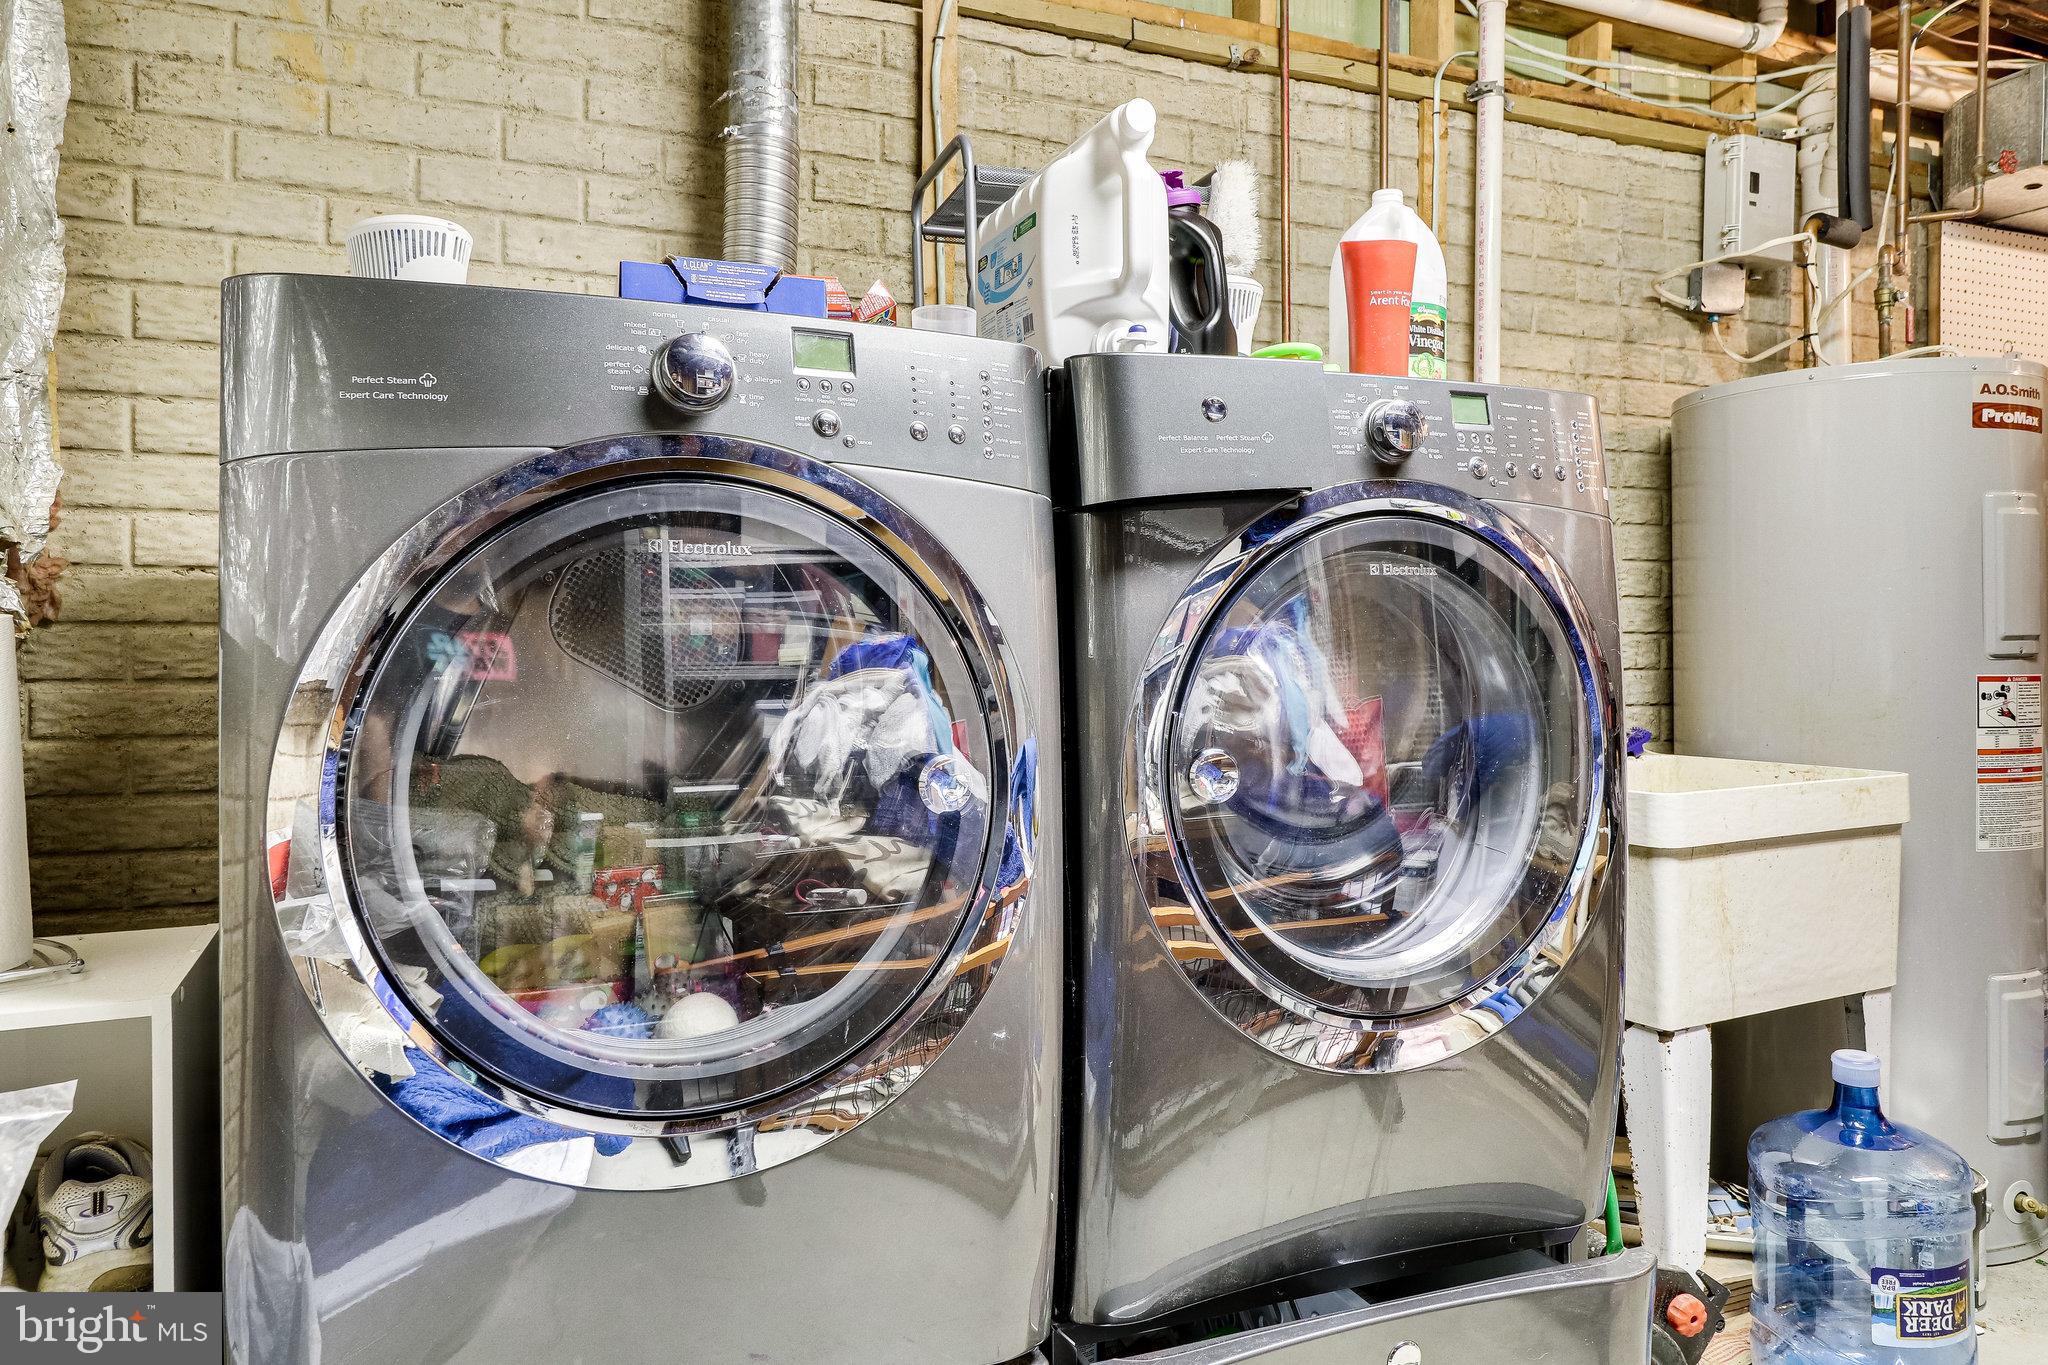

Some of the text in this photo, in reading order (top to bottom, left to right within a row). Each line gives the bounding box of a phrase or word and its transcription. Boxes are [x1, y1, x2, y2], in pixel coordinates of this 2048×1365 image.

[1370, 296, 1399, 306] Arent
[652, 311, 678, 319] normal
[606, 344, 636, 352] delicate
[1409, 334, 1444, 352] Vinegar
[604, 361, 631, 369] perfect
[750, 358, 765, 366] duty
[352, 376, 417, 384] Perfect Steam
[754, 376, 782, 384] allergen
[340, 391, 449, 402] Expert Care Technology
[1982, 408, 2040, 426] ProMax
[669, 540, 752, 556] Electrolux
[1382, 564, 1438, 576] Electrolux
[1902, 1298, 1953, 1316] PARK
[1904, 1314, 1954, 1332] DEER
